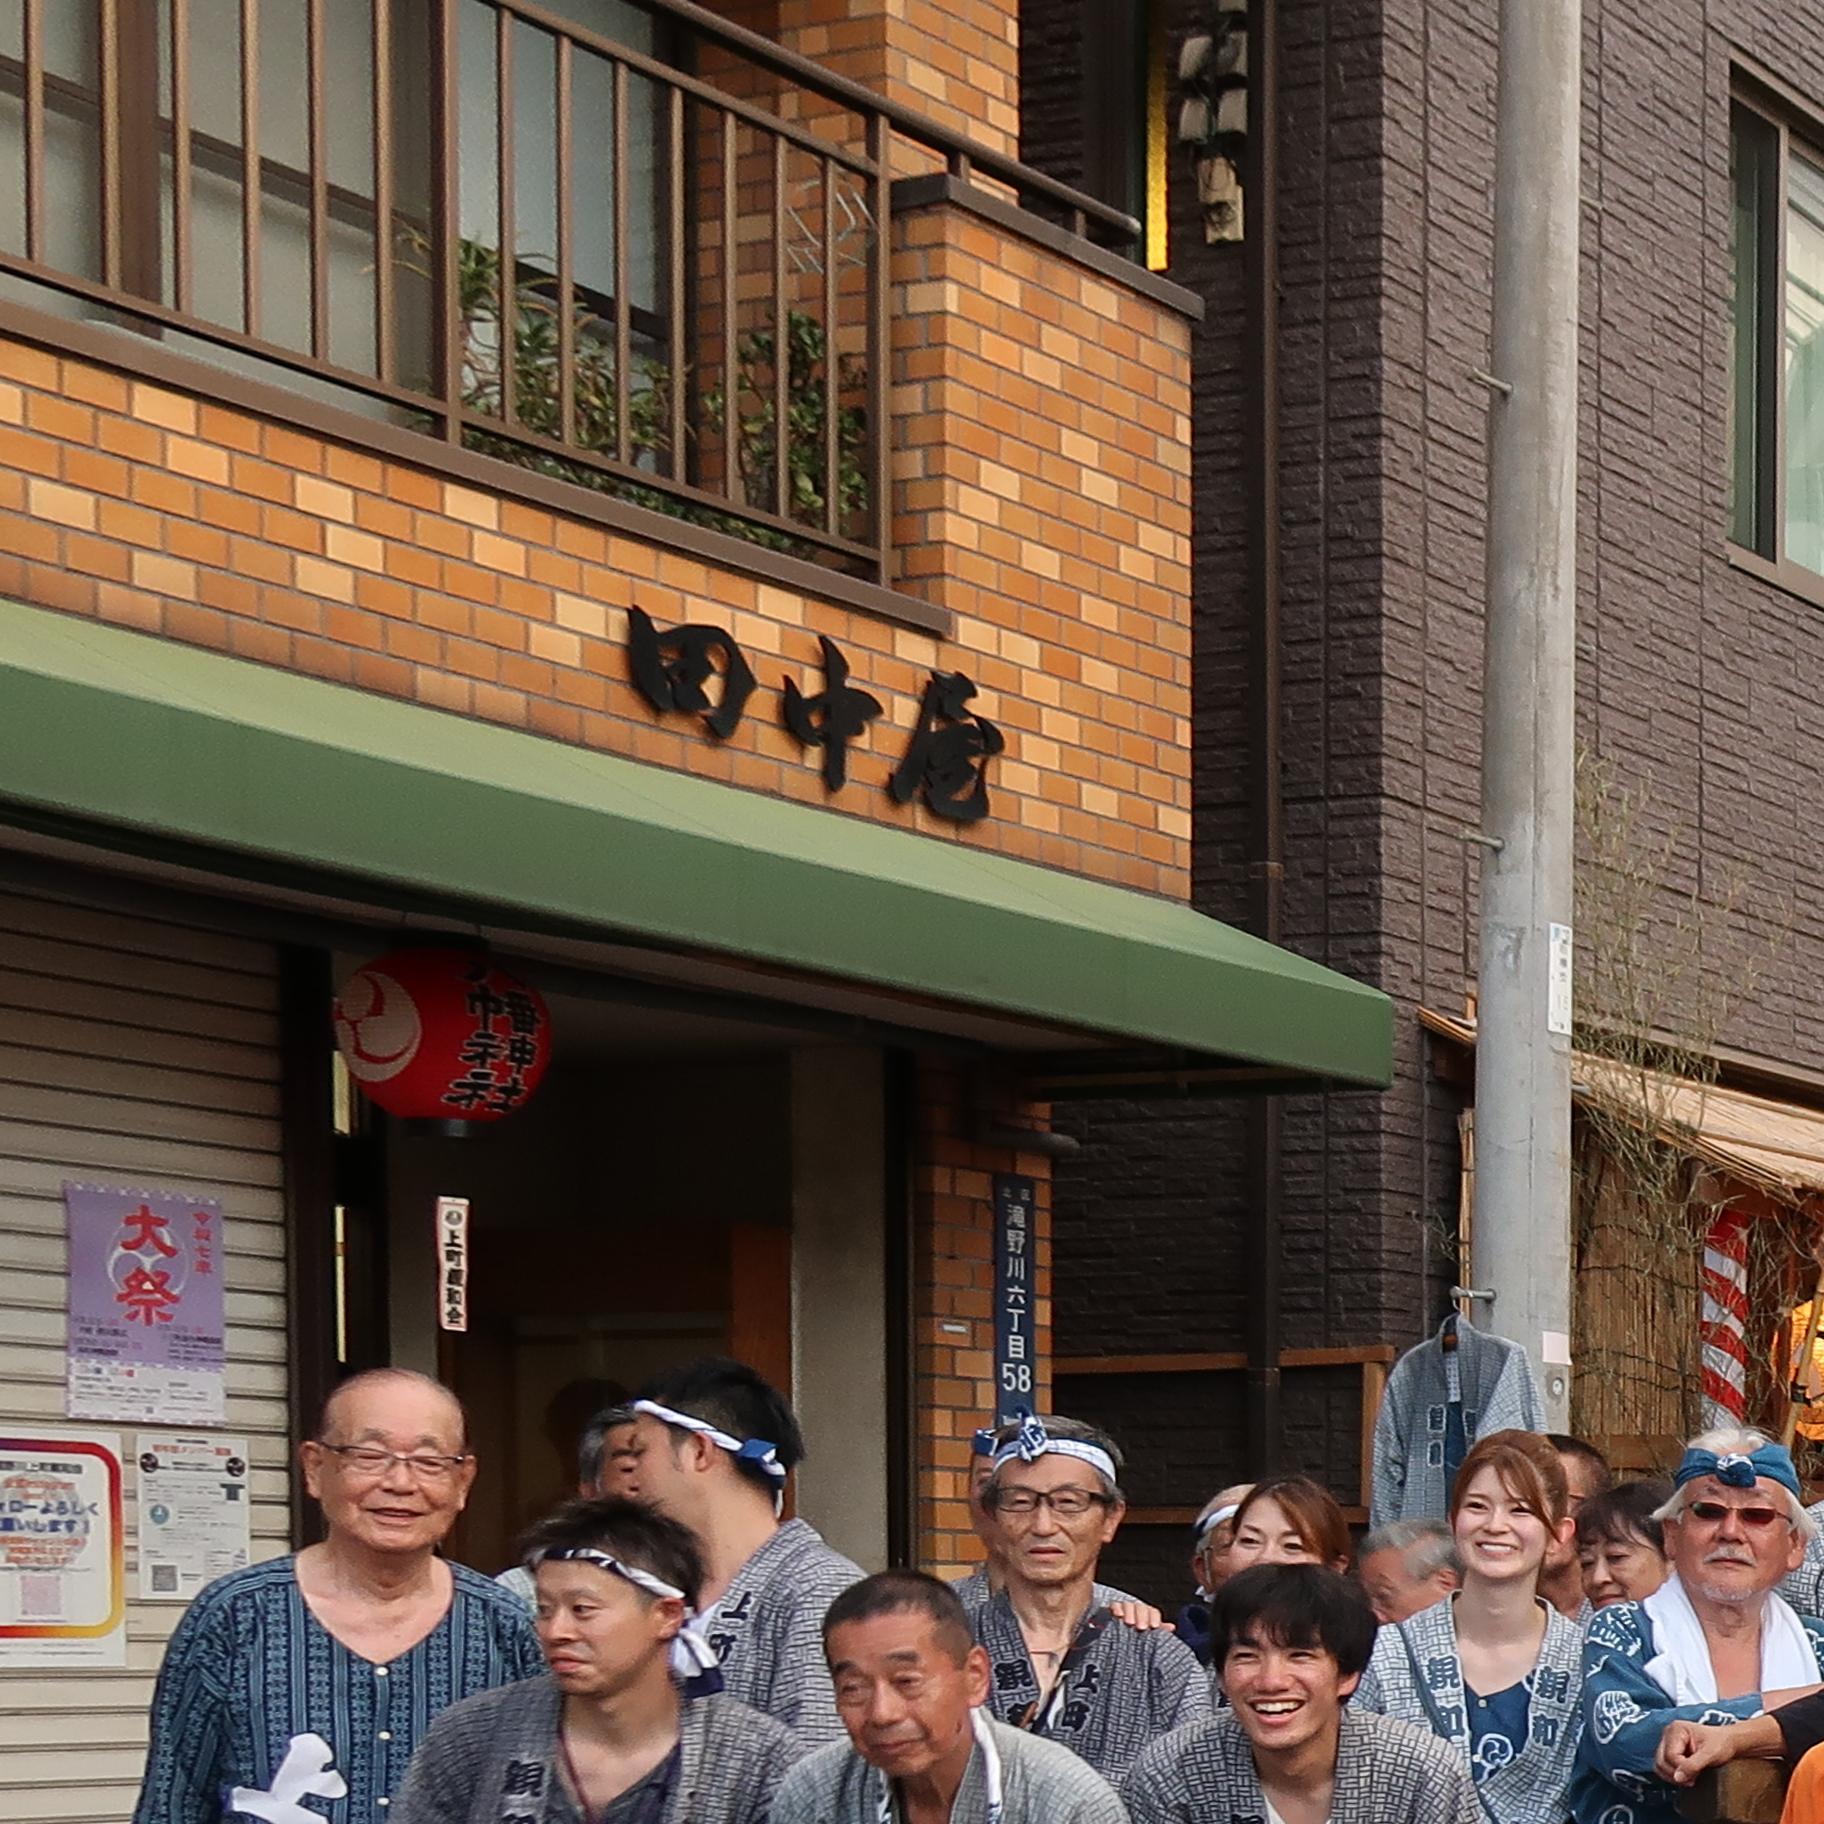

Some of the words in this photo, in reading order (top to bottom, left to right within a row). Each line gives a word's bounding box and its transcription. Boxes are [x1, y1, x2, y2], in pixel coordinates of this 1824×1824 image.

[115, 1204, 181, 1327] 大祭
[1002, 1363, 1031, 1392] 58
[1532, 1664, 1574, 1747] 親和
